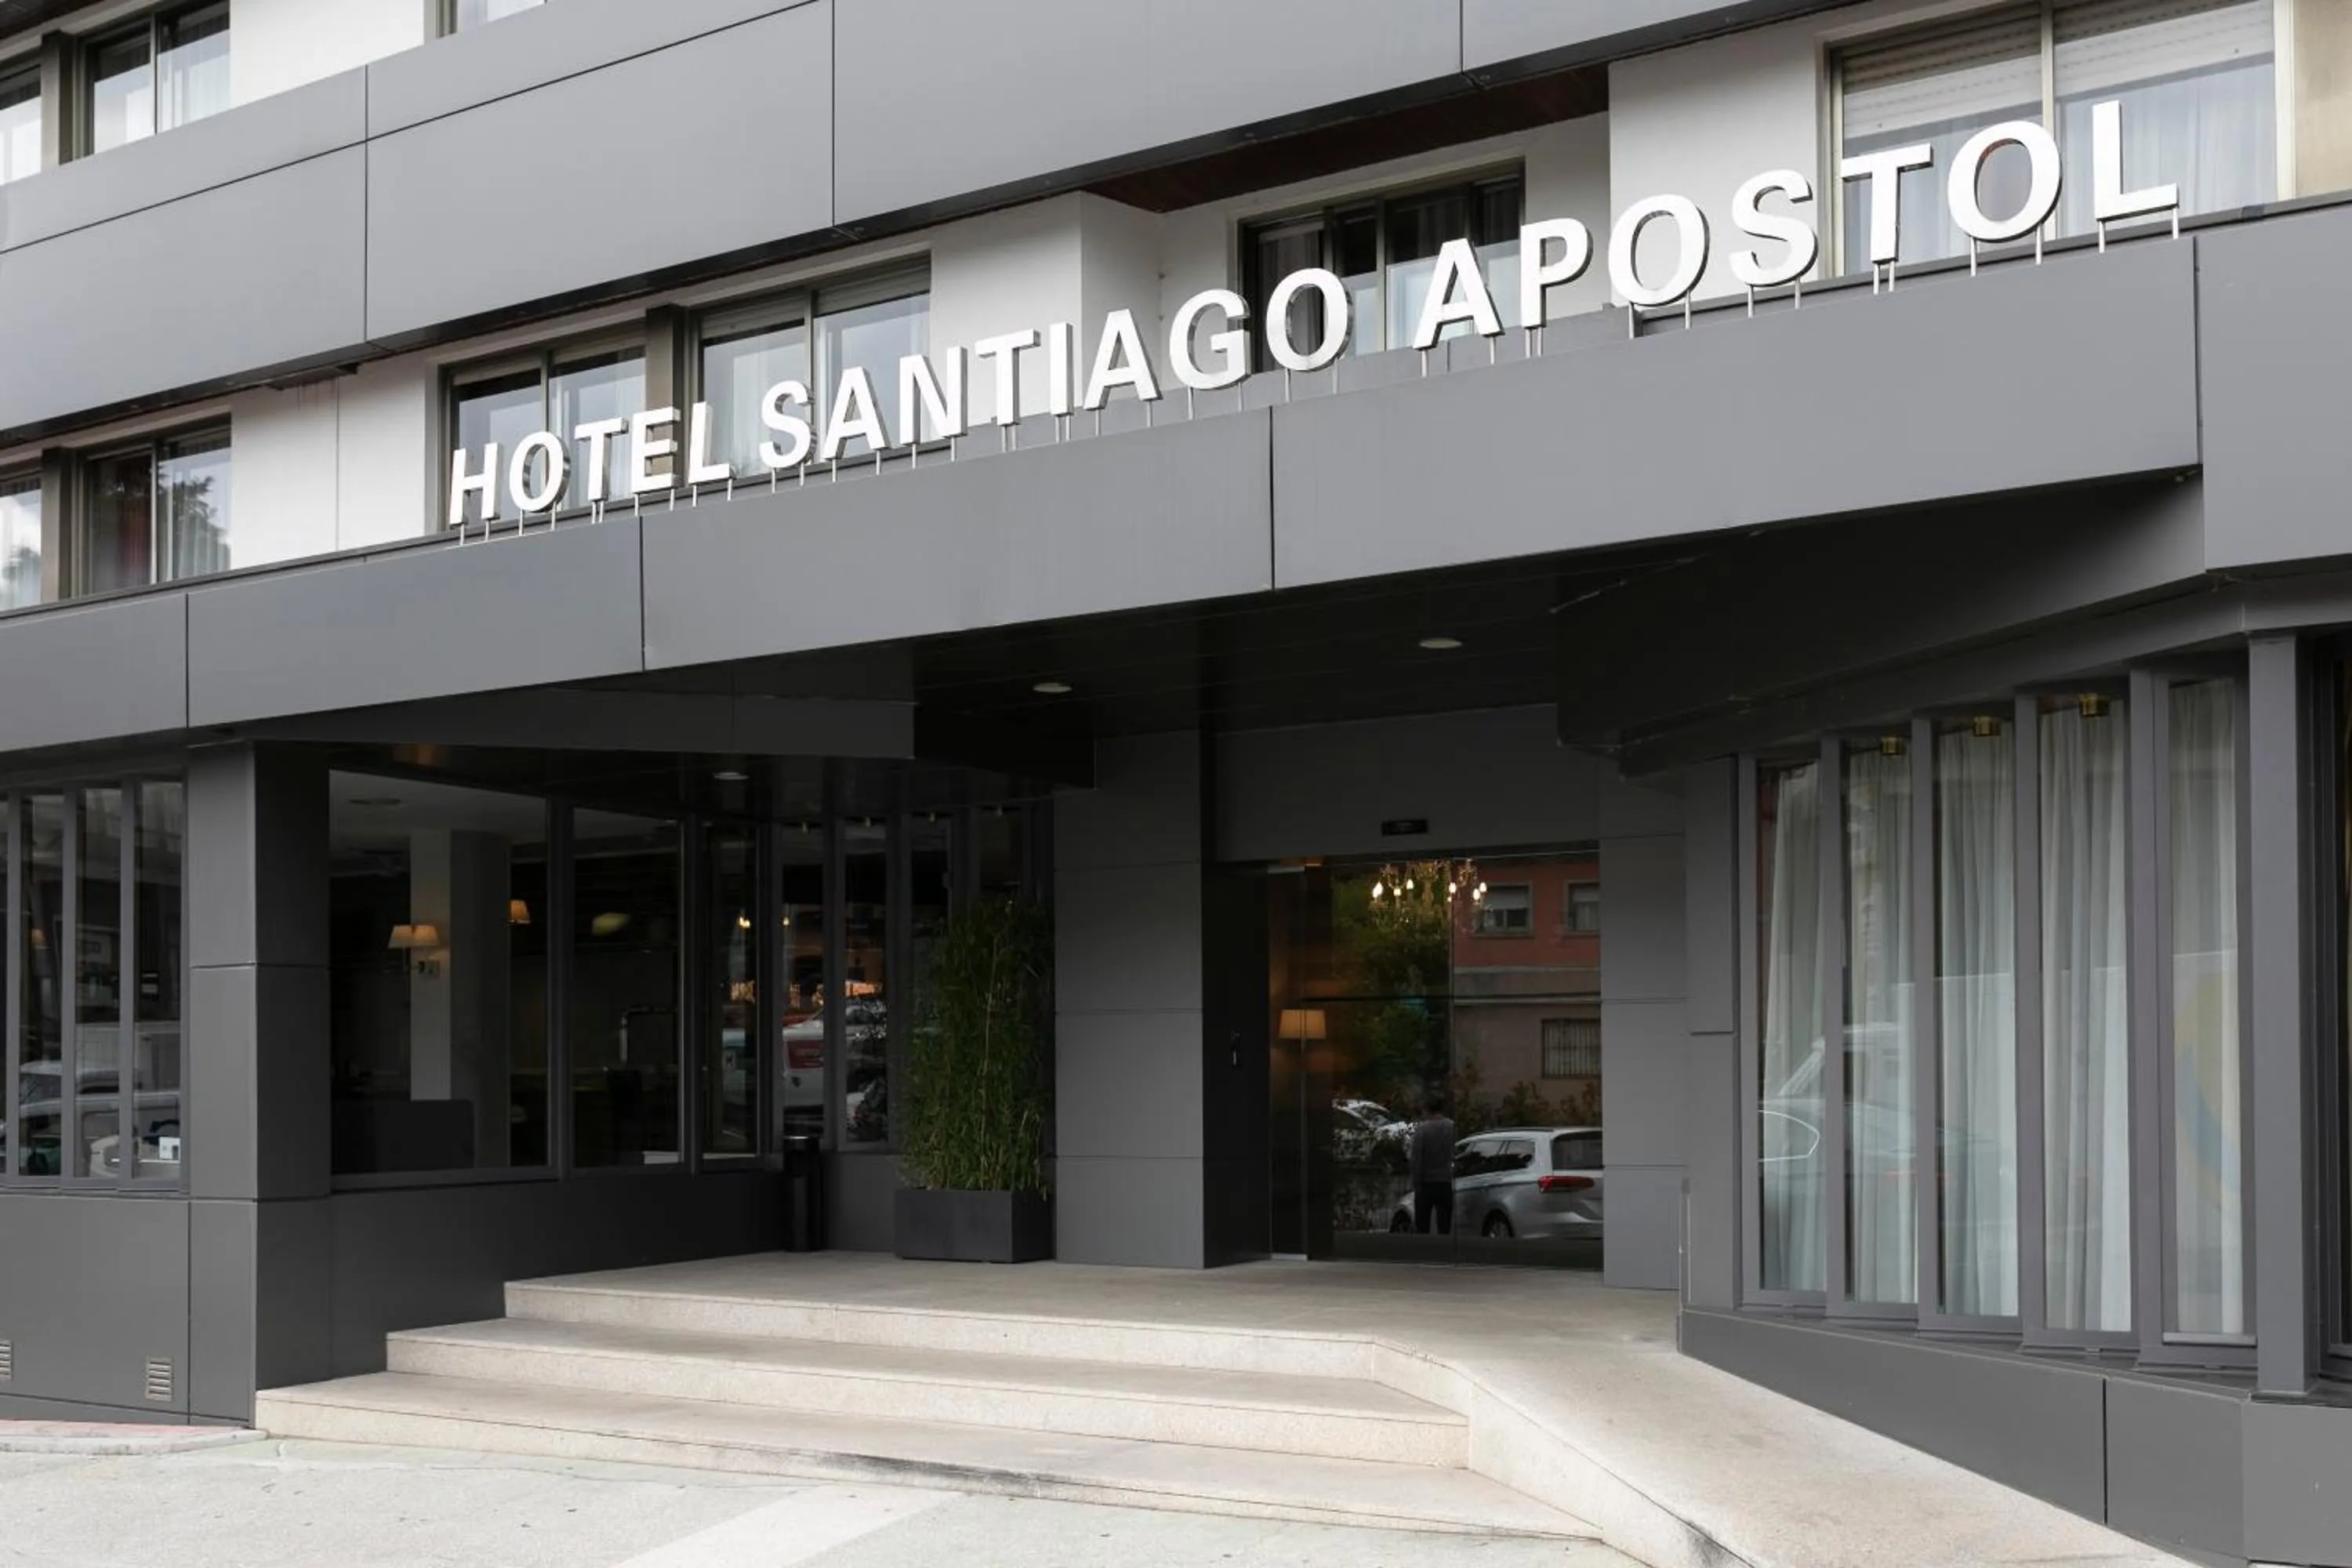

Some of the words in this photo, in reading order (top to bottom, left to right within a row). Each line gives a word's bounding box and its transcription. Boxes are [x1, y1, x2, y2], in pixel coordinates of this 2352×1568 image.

[448, 401, 736, 525] HOTEL
[759, 267, 1353, 468] SANTIAGO
[1412, 100, 2180, 350] APOSTOL
